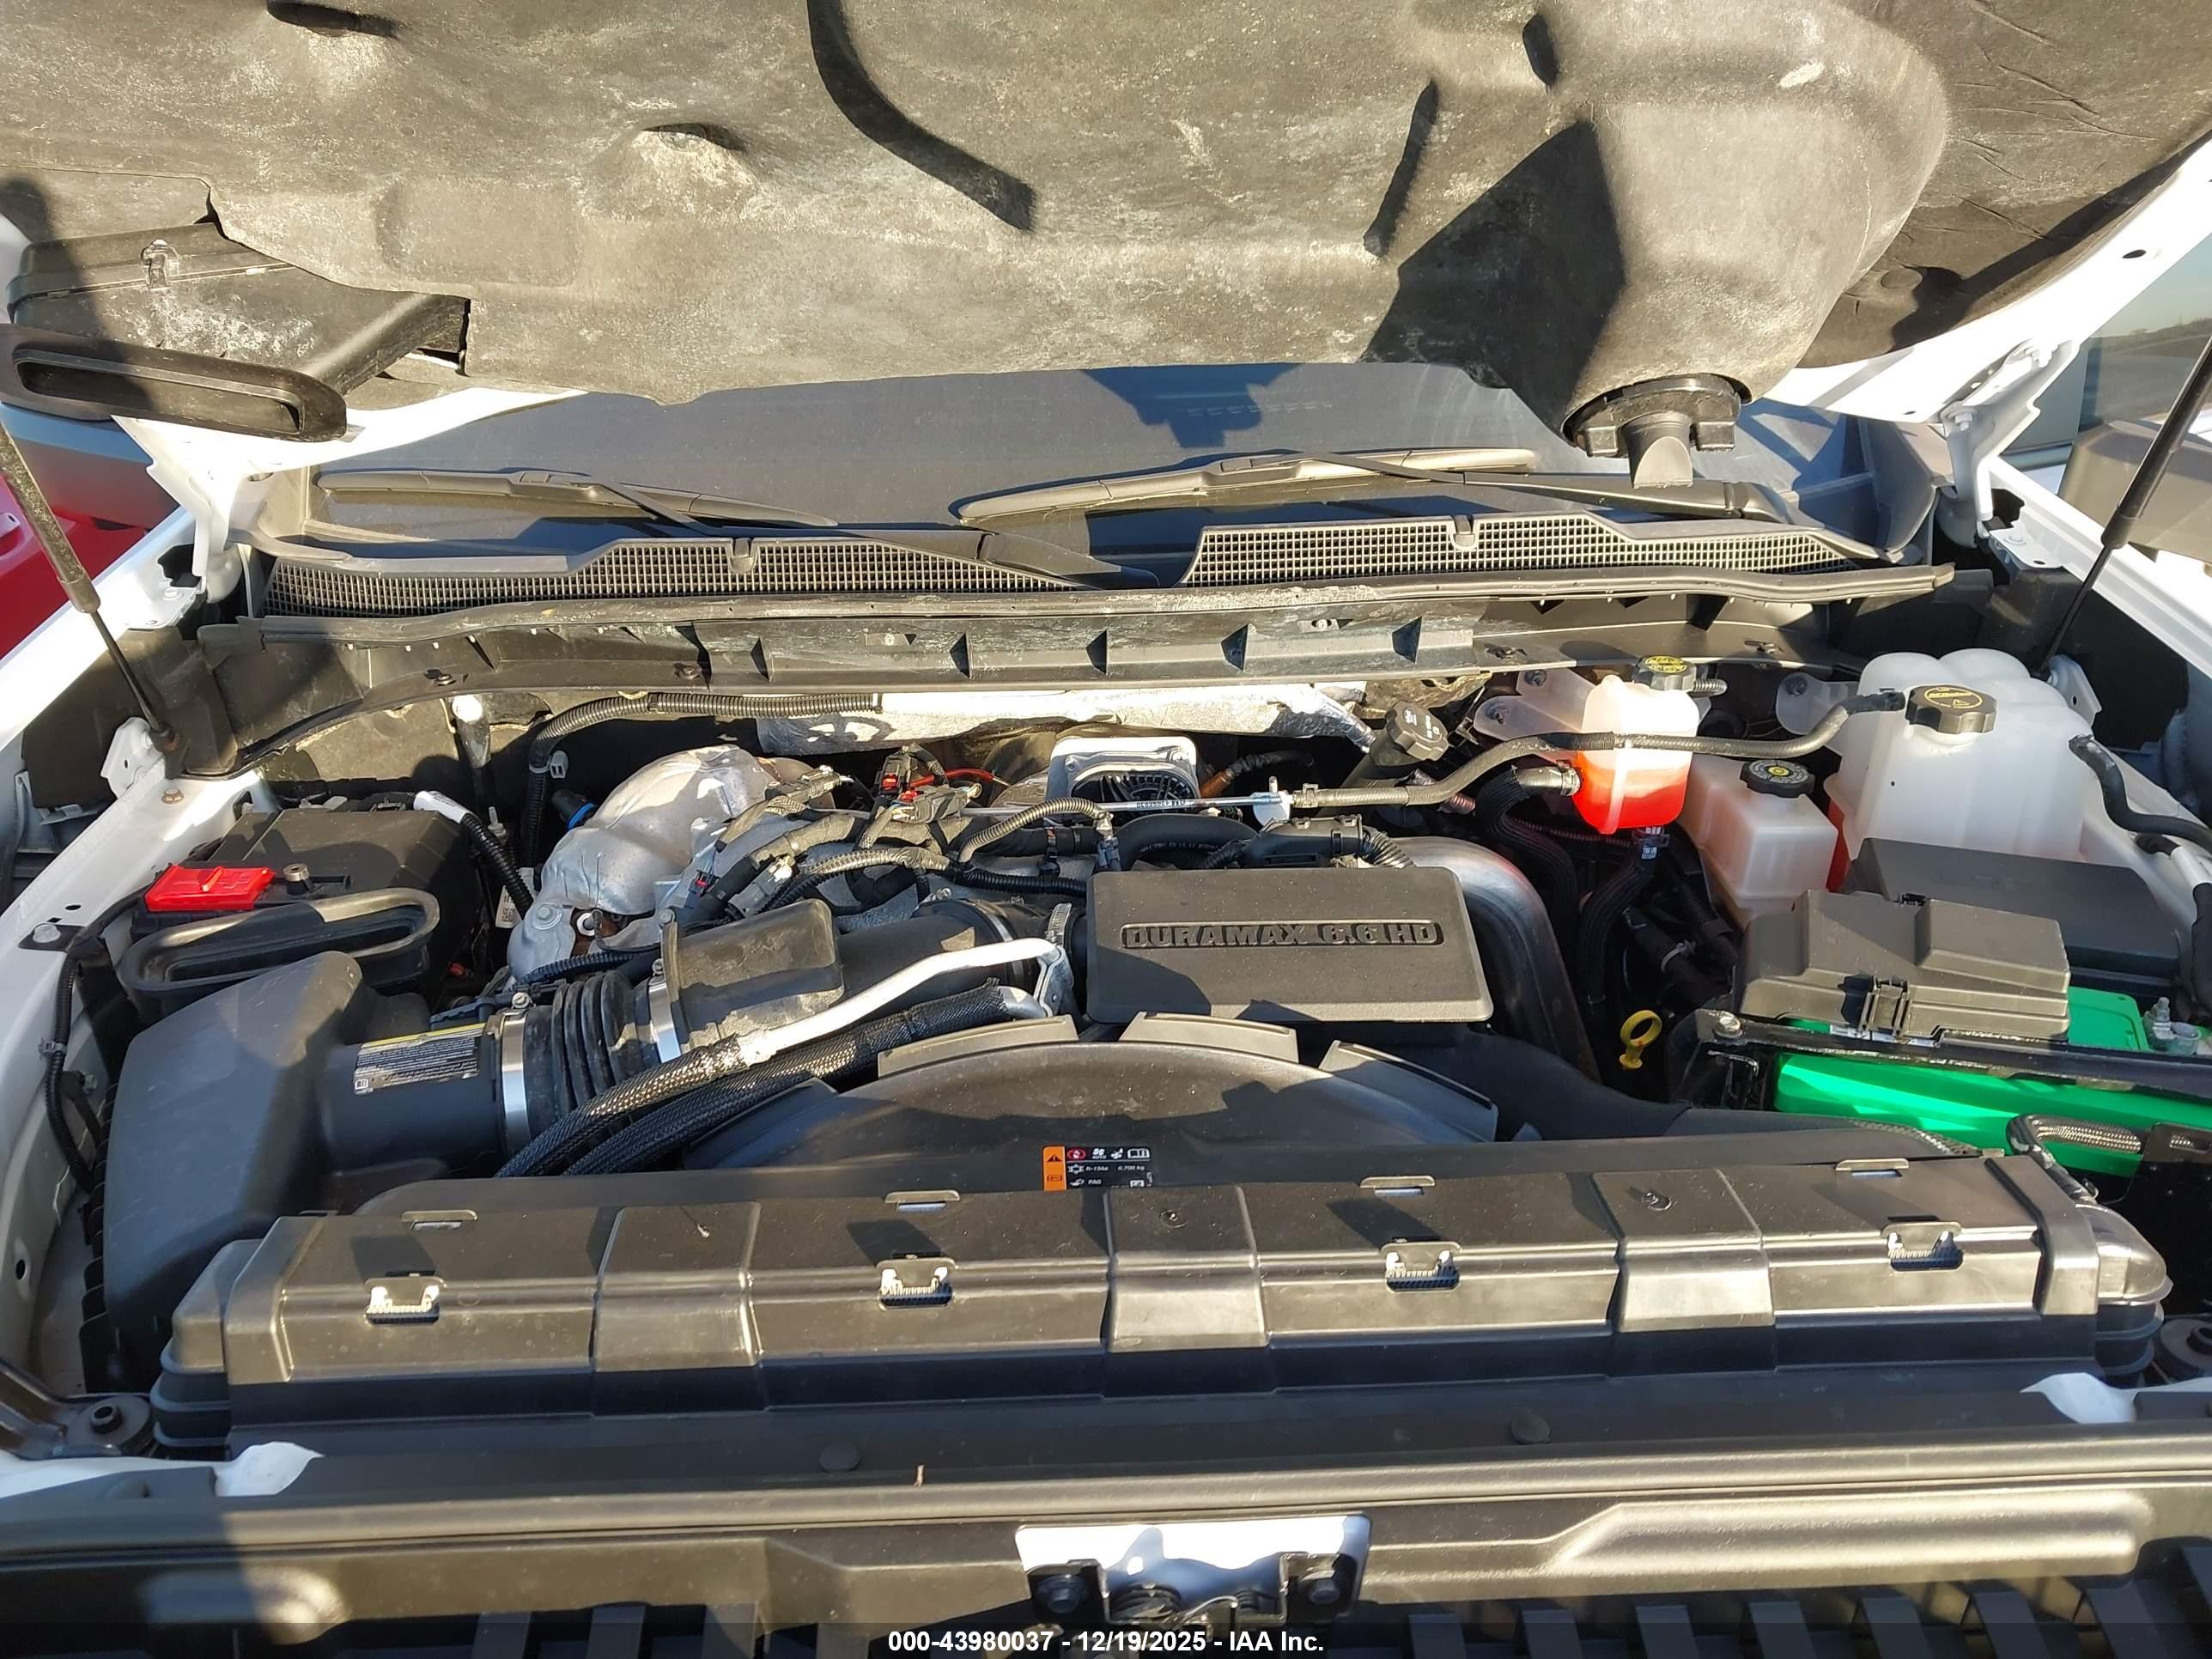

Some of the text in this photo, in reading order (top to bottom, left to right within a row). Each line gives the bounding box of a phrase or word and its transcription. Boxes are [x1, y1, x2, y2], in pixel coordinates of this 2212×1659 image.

[1125, 923, 1438, 947] DURAMAX 6.6 HD
